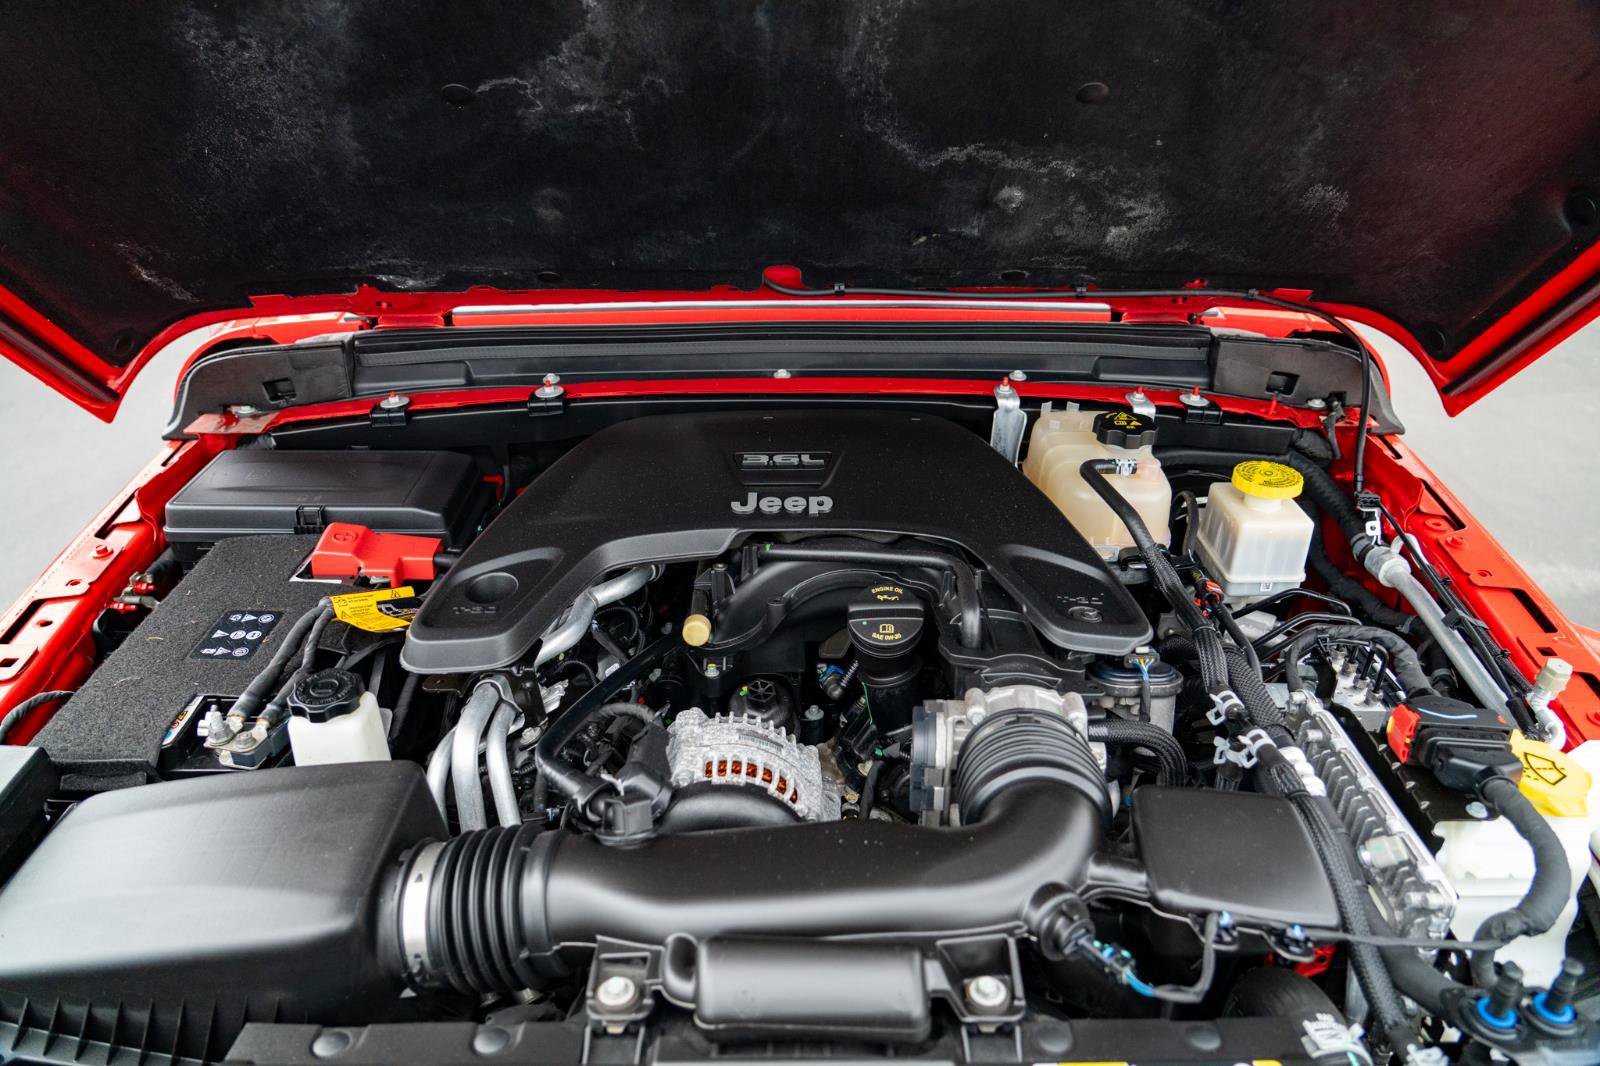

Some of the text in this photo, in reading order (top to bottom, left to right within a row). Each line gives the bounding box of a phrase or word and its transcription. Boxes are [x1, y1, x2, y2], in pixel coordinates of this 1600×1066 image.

[742, 454, 825, 466] 3.6L
[730, 492, 834, 516] Jeep
[871, 586, 894, 594] ENGINE
[871, 632, 884, 640] SAE
